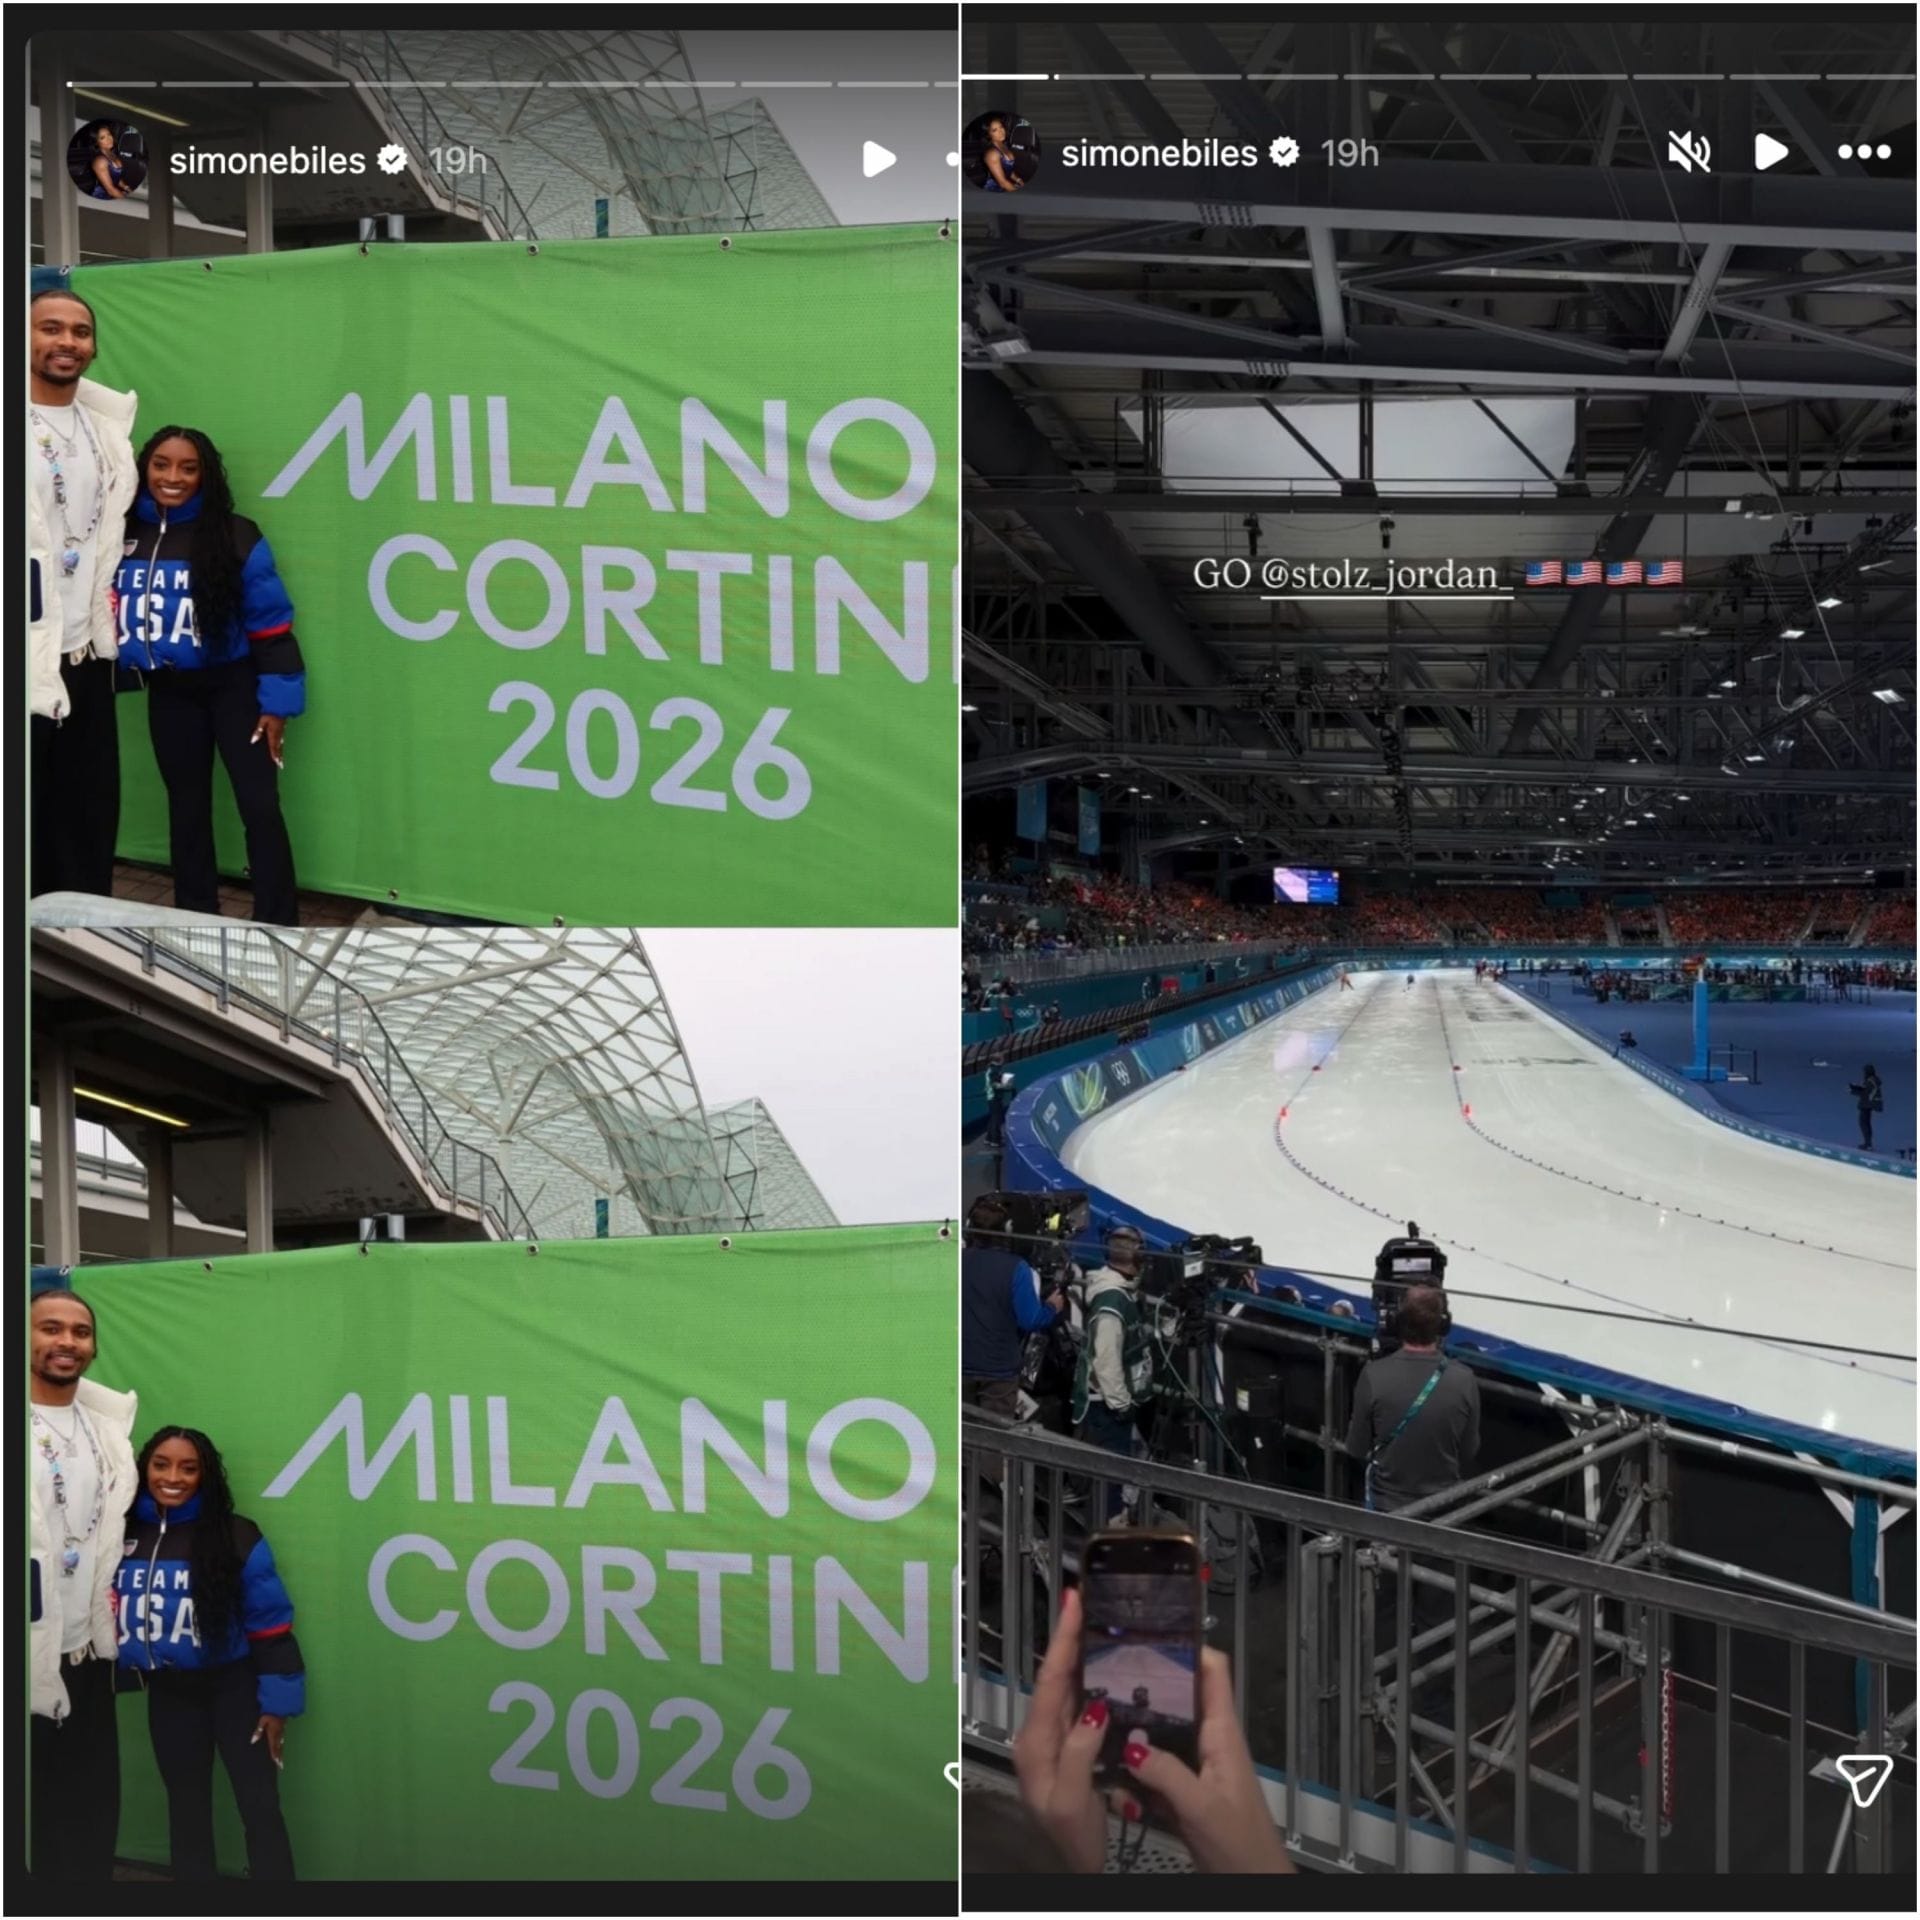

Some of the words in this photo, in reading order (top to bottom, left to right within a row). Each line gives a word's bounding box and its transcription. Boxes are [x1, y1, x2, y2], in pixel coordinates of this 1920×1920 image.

[261, 392, 936, 521] MILANO
[117, 568, 190, 590] TEAM
[367, 533, 958, 684] CORTIN
[488, 680, 812, 820] 2026
[261, 1392, 936, 1521] MILANO
[117, 1568, 190, 1590] TEAM
[367, 1533, 958, 1684] CORTIN
[488, 1680, 812, 1820] 2026
